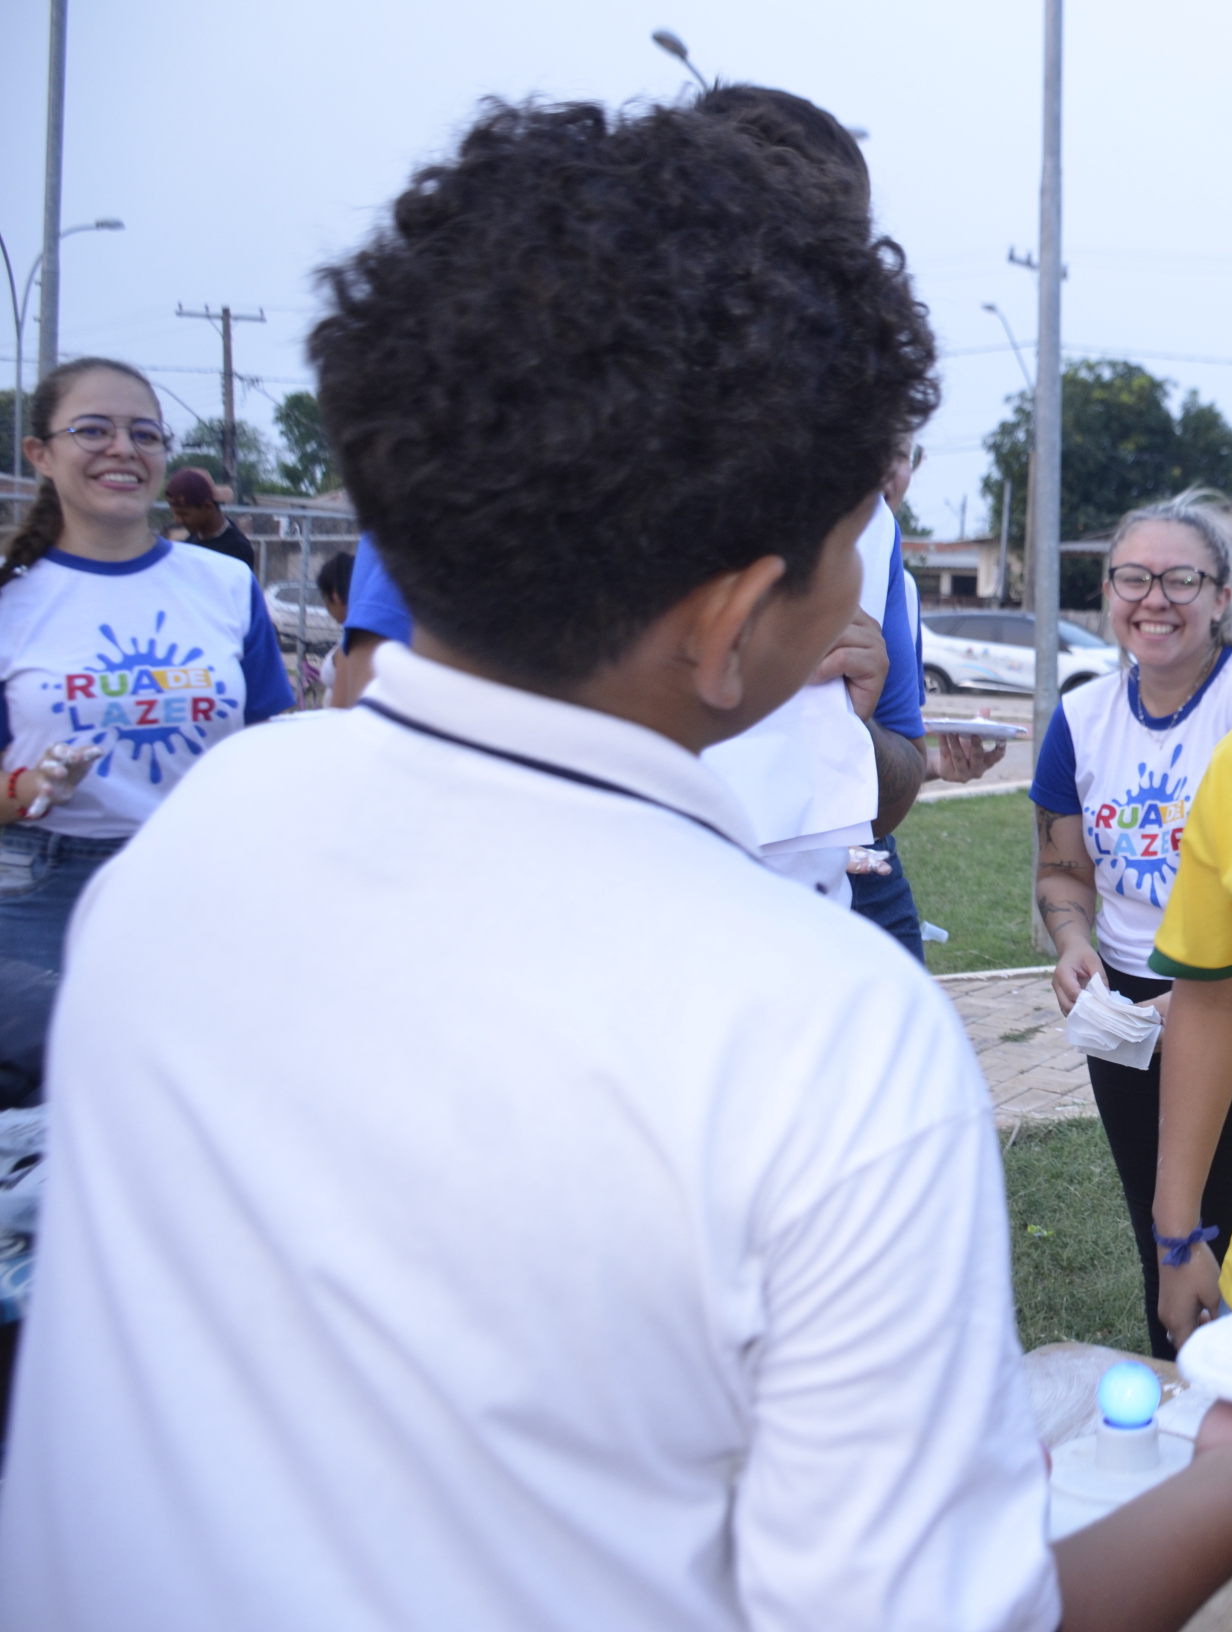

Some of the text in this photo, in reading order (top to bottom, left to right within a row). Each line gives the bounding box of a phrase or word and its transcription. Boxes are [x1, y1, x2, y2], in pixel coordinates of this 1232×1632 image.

[66, 669, 209, 700] RUA DE
[68, 697, 216, 731] LAZER
[1095, 804, 1163, 829] RUA
